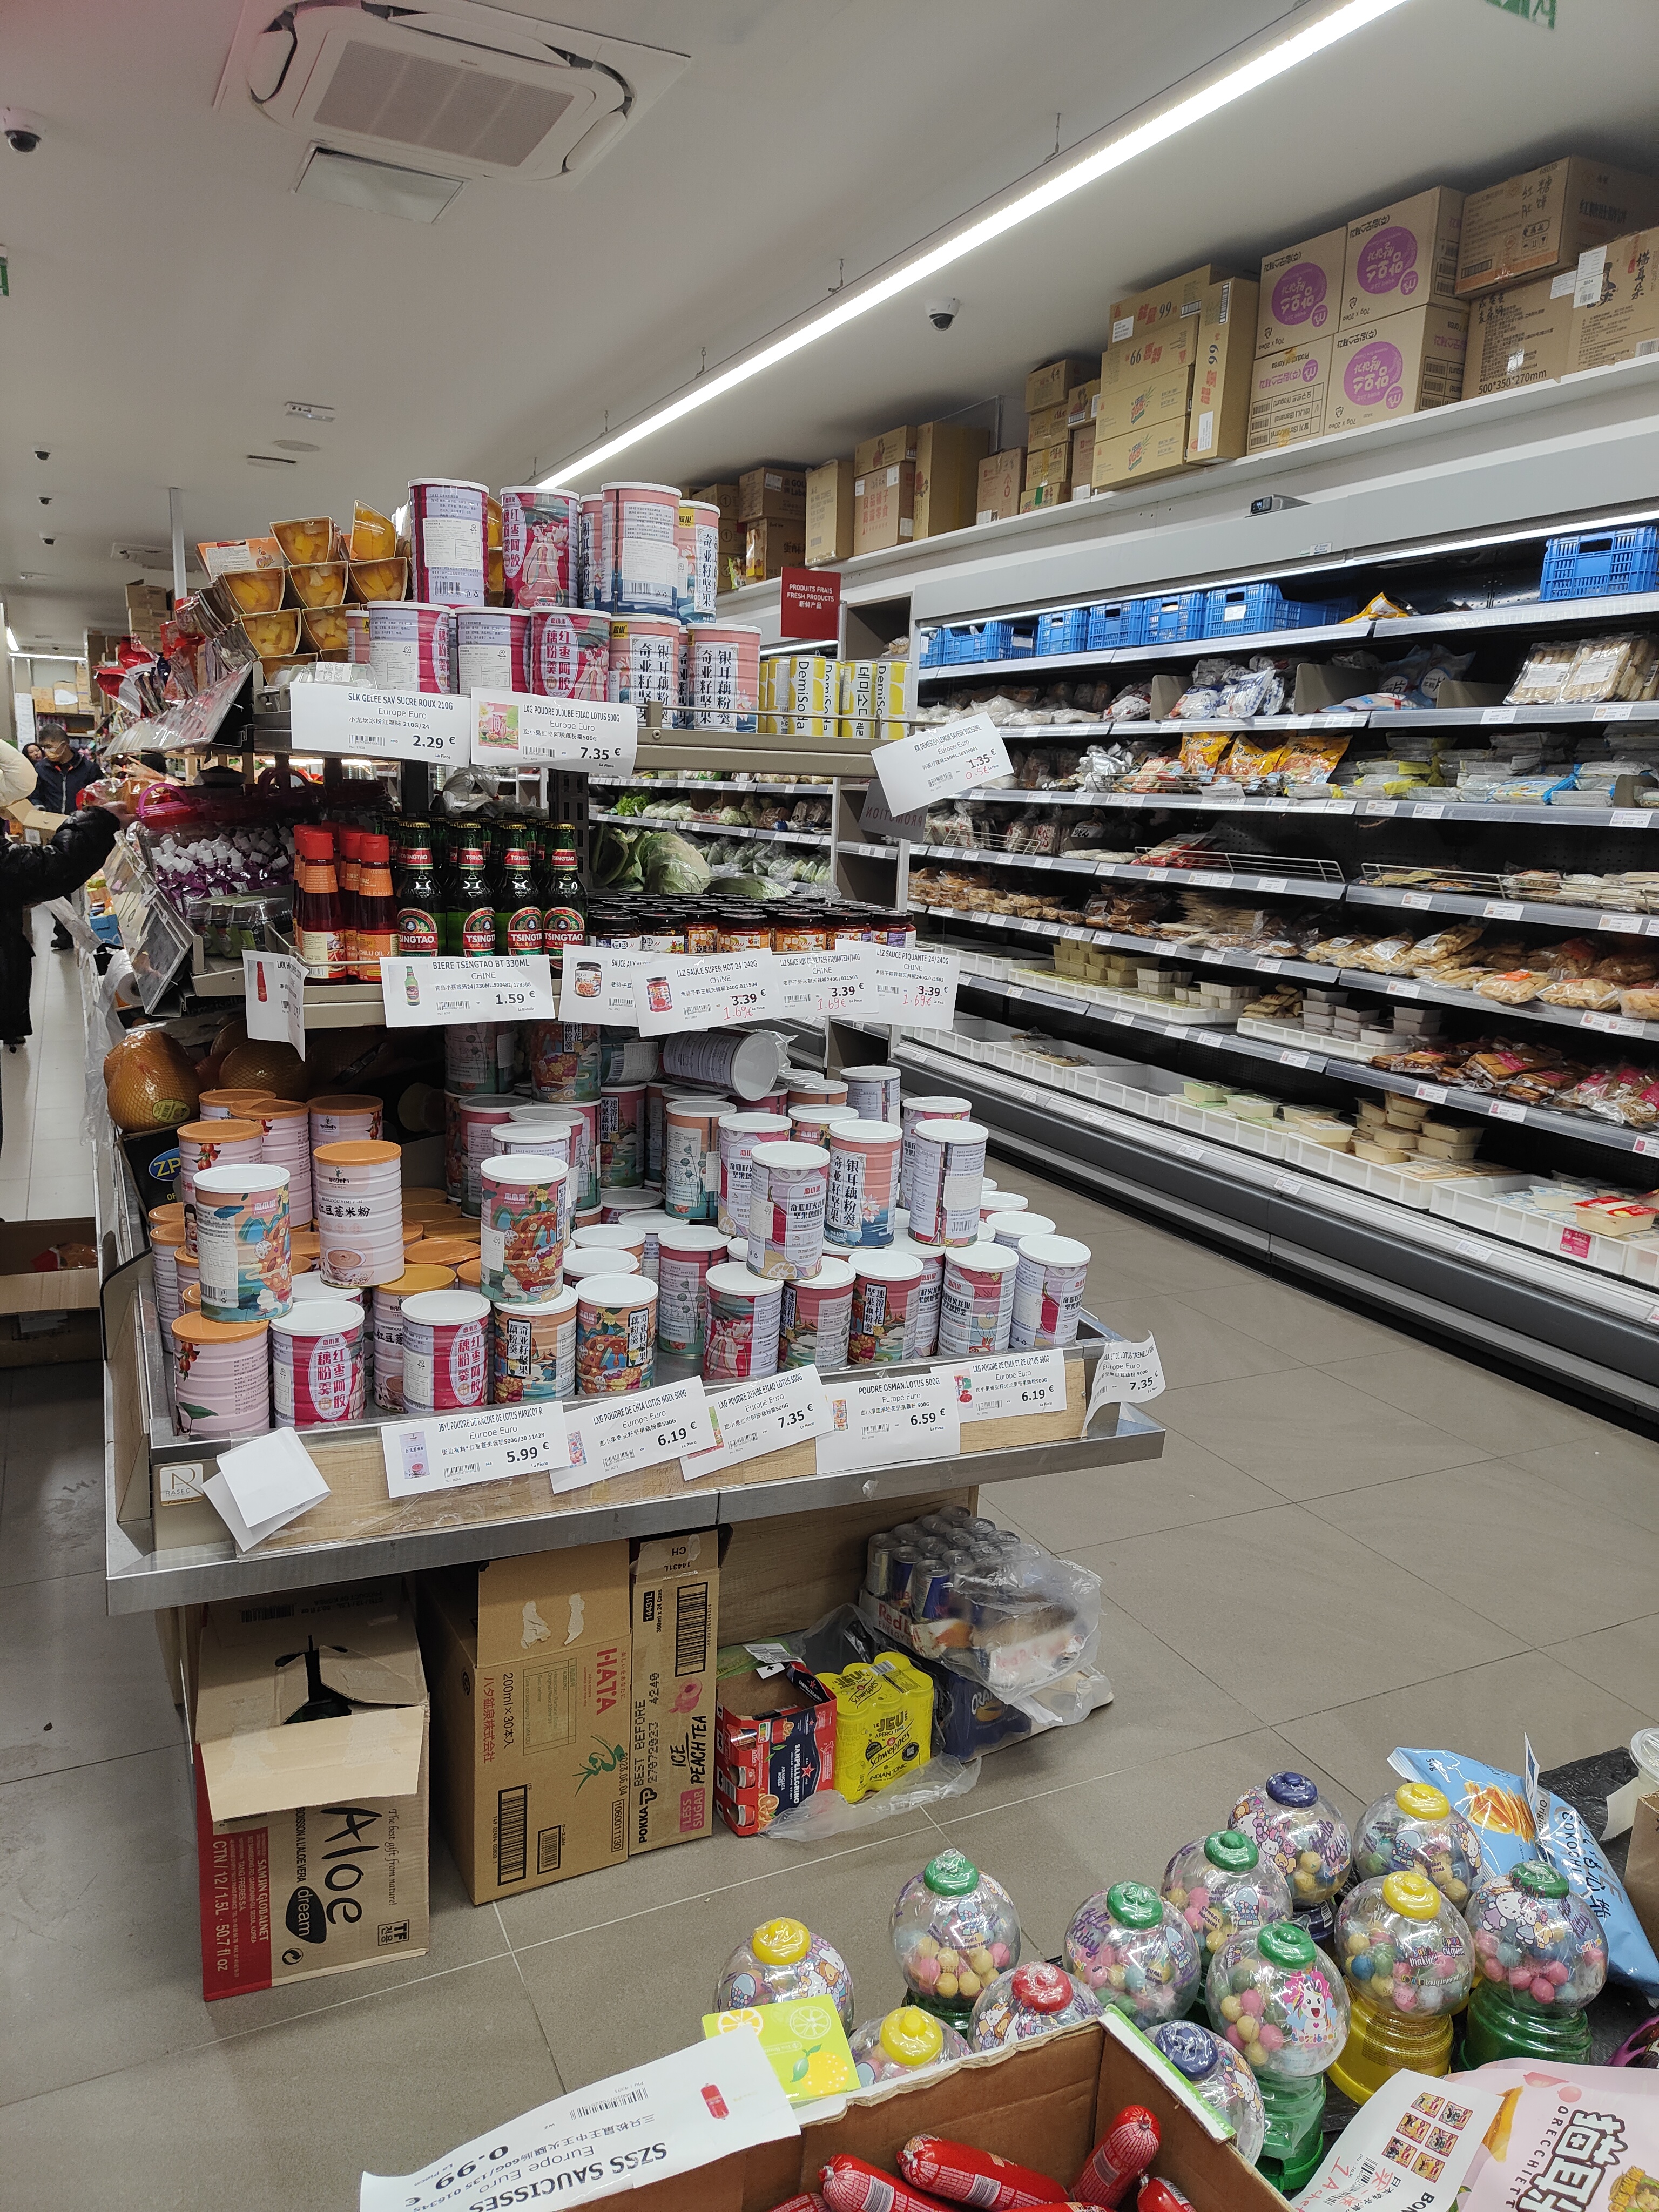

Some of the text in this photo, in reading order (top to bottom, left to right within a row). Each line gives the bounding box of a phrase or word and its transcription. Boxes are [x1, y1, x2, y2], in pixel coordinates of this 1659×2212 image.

[789, 584, 815, 592] PRODUITS
[799, 600, 822, 609] 新鲜产品
[806, 594, 834, 602] PRODUCTS
[558, 632, 570, 691] 红枣阿胶
[348, 693, 453, 710] SLK GELEE SAV SUCRE ROUX 210G
[378, 708, 427, 719] Europe Euro
[523, 704, 620, 722] LXG POUDRE JUJUBE EJIAO LOTUS 500G
[550, 721, 576, 730] Europe
[413, 736, 443, 748] 2.29
[957, 740, 969, 748] Euro
[581, 747, 609, 760] 7.35
[544, 933, 583, 941] TSINGTAO
[433, 959, 530, 971] BIERE TSINGTAO BT 330ML
[705, 965, 721, 973] SUPER
[735, 960, 758, 970] 24/240G
[886, 950, 901, 959] SAUCE
[902, 952, 927, 962] PIQUANTE
[928, 955, 949, 965] 24/240G
[471, 972, 496, 980] CHINE
[710, 975, 731, 983] CHINE
[495, 993, 525, 1005] 1.59
[831, 986, 855, 997] 3.39
[918, 985, 940, 996] 3.39
[732, 994, 757, 1006] 3.39
[843, 1158, 859, 1226] 银耳藕粉羹
[470, 1334, 481, 1393] 红枣阿胶
[973, 1365, 981, 1373] LXG
[981, 1362, 998, 1372] POUDRE
[999, 1361, 1004, 1370] DE
[1004, 1360, 1015, 1368] CHIA
[1015, 1359, 1020, 1367] ET
[1026, 1357, 1039, 1366] LOTUS
[1040, 1355, 1049, 1363] 500G
[332, 1348, 347, 1409] 红枣阿胶
[859, 1377, 940, 1394] POUDRE OSMAN.LOTUS 500G
[996, 1372, 1016, 1381] Europe
[1129, 1377, 1153, 1391] 7.35
[718, 1373, 802, 1410] LXG POUDRE JUJUBE EJIAO LOTUS 500G
[882, 1394, 905, 1403] Europe
[1022, 1389, 1046, 1402] 6.19
[593, 1389, 687, 1425] LXG POUDRE DE CHIA LOTUS NOIX 500G
[450, 1419, 470, 1430] POUDRE
[496, 1414, 502, 1422] DE
[503, 1412, 517, 1421] LOTUS
[518, 1409, 538, 1419] HARICOT
[539, 1407, 543, 1415] R
[622, 1410, 666, 1428] Europe Euro
[778, 1410, 805, 1429] 7.35
[911, 1412, 936, 1426] 6.59
[528, 1432, 544, 1441] 11428
[658, 1428, 686, 1446] 6.19
[507, 1447, 538, 1464] 5.99
[165, 1488, 191, 1496] RASEC
[671, 1546, 687, 1556] CH
[645, 1593, 654, 1620] 14431L
[596, 1647, 617, 1716] HATA
[875, 1724, 906, 1739] APERO TIME
[878, 1715, 905, 1732] JEU
[635, 1699, 645, 1787] BEST BEFORE
[690, 1715, 707, 1785] PEACH TEA
[869, 1730, 911, 1768] Schweppes
[670, 1744, 686, 1768] ICE
[681, 1799, 692, 1824] LESS
[692, 1790, 704, 1827] SUGAR
[613, 1802, 623, 1849] 1060011130
[638, 1806, 649, 1844] POKKA
[321, 1806, 384, 1926] Aloe
[384, 1808, 399, 1906] The best gift from nature!
[296, 1865, 307, 1883] VERA
[212, 1840, 233, 1972] CTN 12 1.5L 50.7 oz
[257, 1858, 269, 1941] SAMJIN GLOBALNET
[296, 1888, 313, 1936] dream
[380, 1925, 394, 1944] 전용
[393, 1923, 407, 1941] TF
[435, 2146, 509, 2190] 0.99
[469, 2142, 667, 2212] SZSS SAUCISSES
[478, 2145, 595, 2194] Europe Euro
